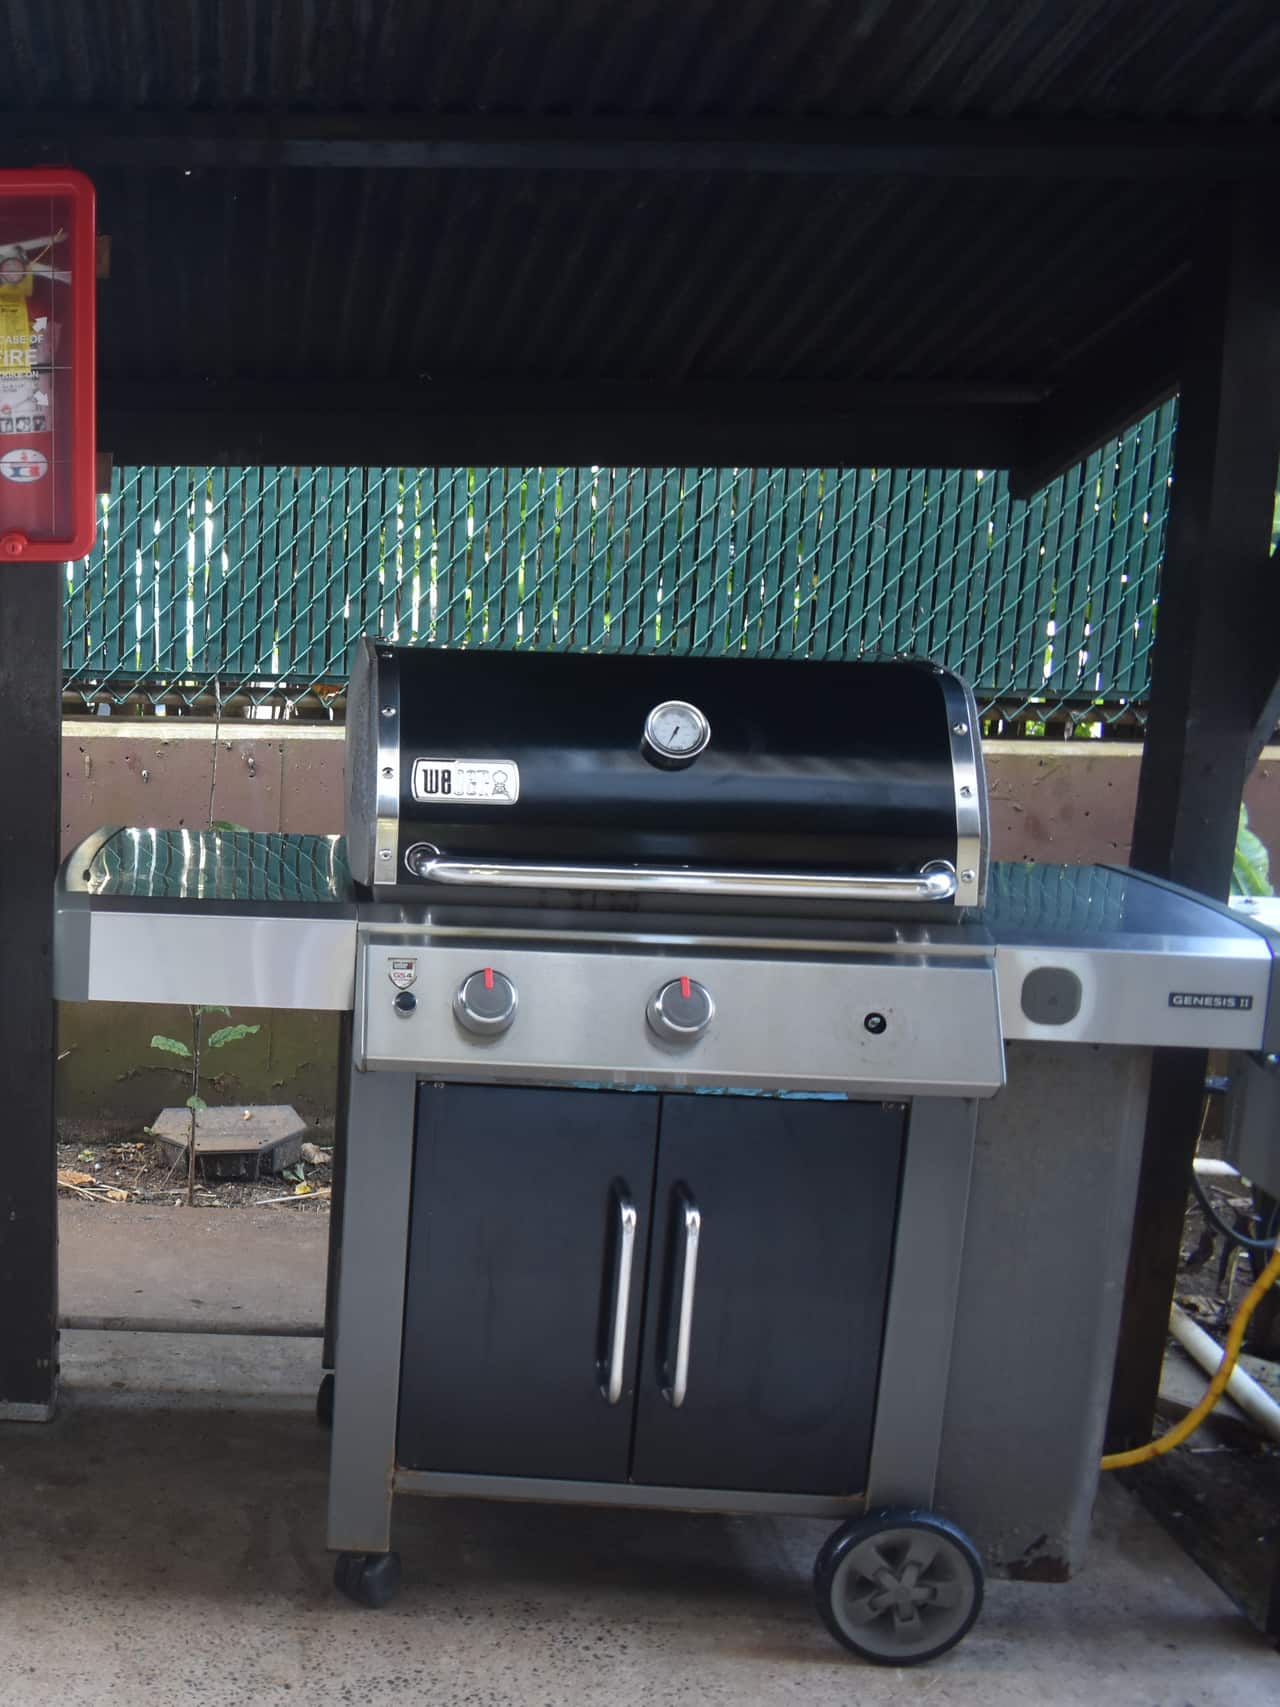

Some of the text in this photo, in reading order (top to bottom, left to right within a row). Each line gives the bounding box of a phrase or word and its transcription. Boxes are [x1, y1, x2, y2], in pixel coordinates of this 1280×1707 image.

[29, 334, 44, 343] OF
[422, 768, 489, 796] weer
[1172, 995, 1236, 1009] GENESIS
